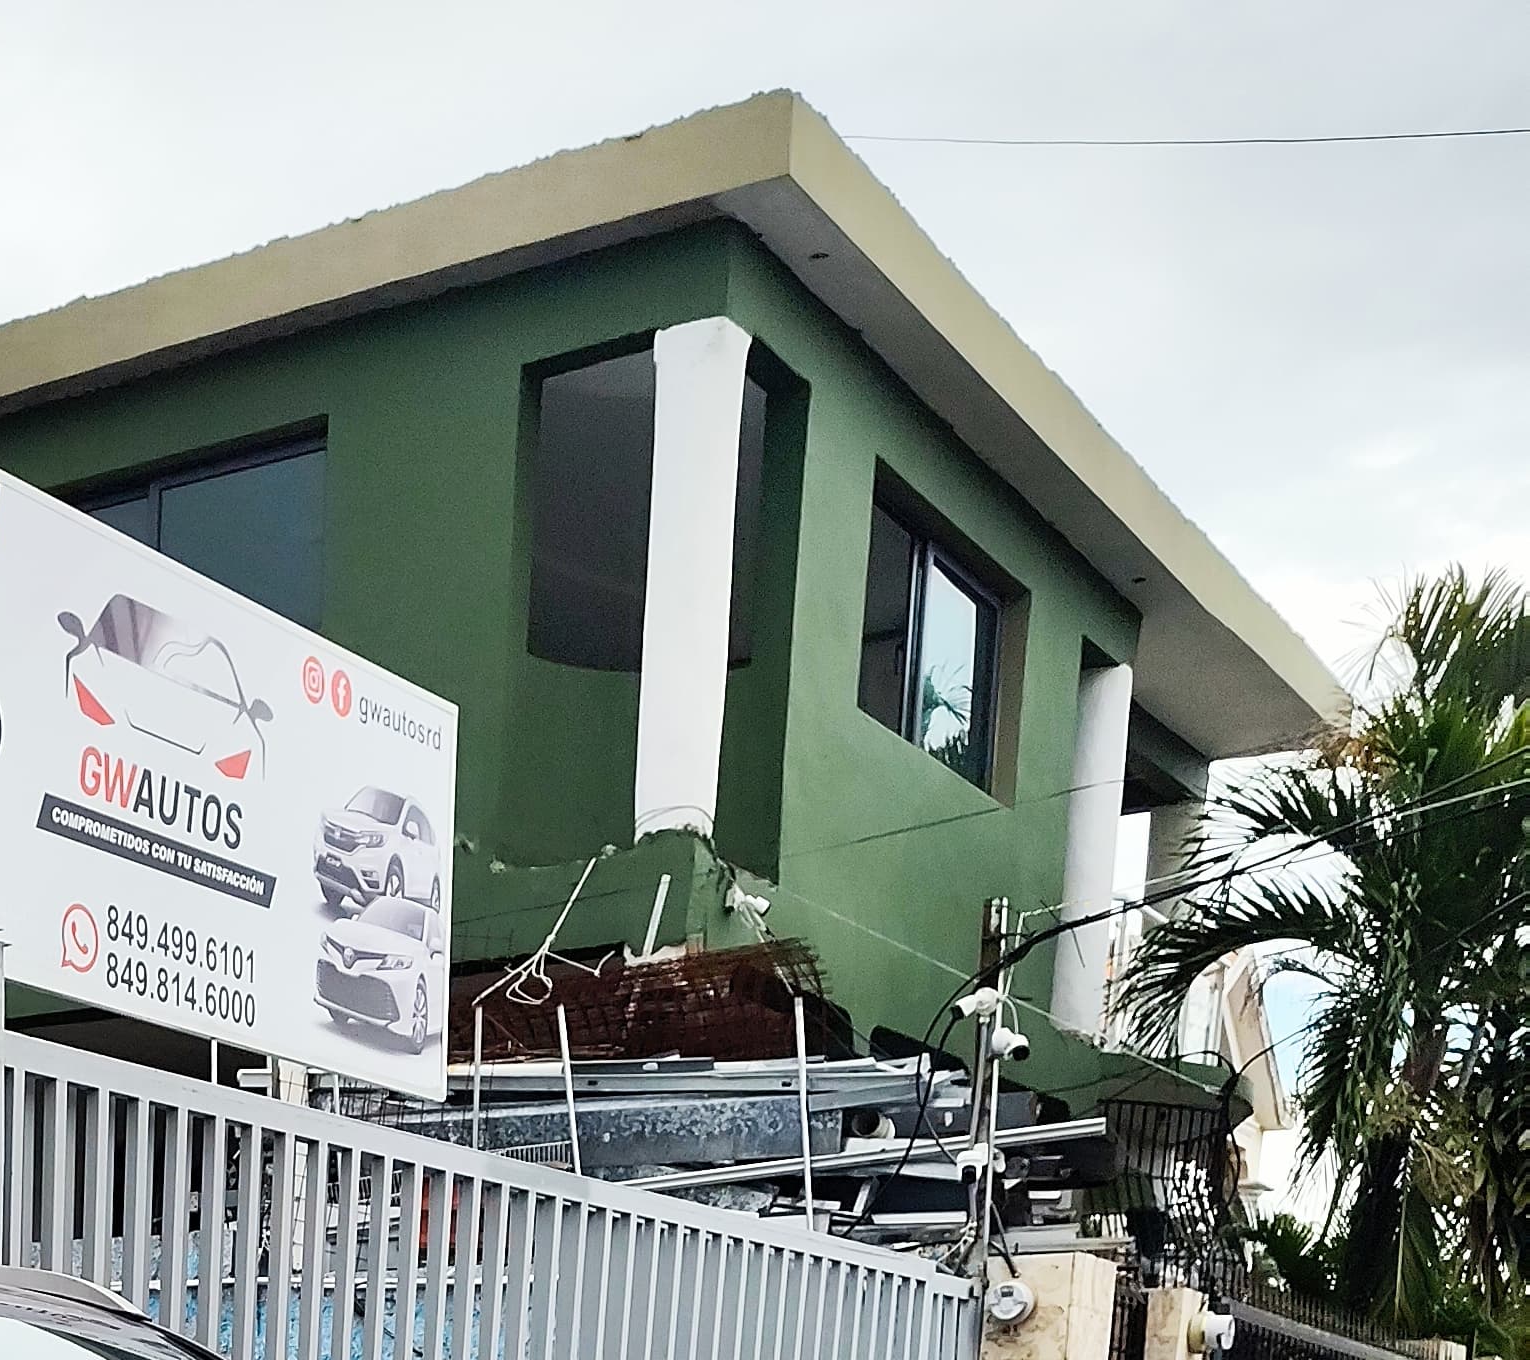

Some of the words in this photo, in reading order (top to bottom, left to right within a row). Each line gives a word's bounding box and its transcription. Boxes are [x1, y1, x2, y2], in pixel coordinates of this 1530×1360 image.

[359, 697, 441, 751] gwautosrd
[79, 746, 244, 850] GWAUTOS
[51, 807, 150, 855] COMPROMETIDOS
[151, 842, 175, 864] CON
[176, 851, 192, 870] TU
[193, 858, 265, 895] SATISFACCIÓN
[106, 904, 256, 984] 849.499.6101
[105, 951, 256, 1028] 849.814.6000
